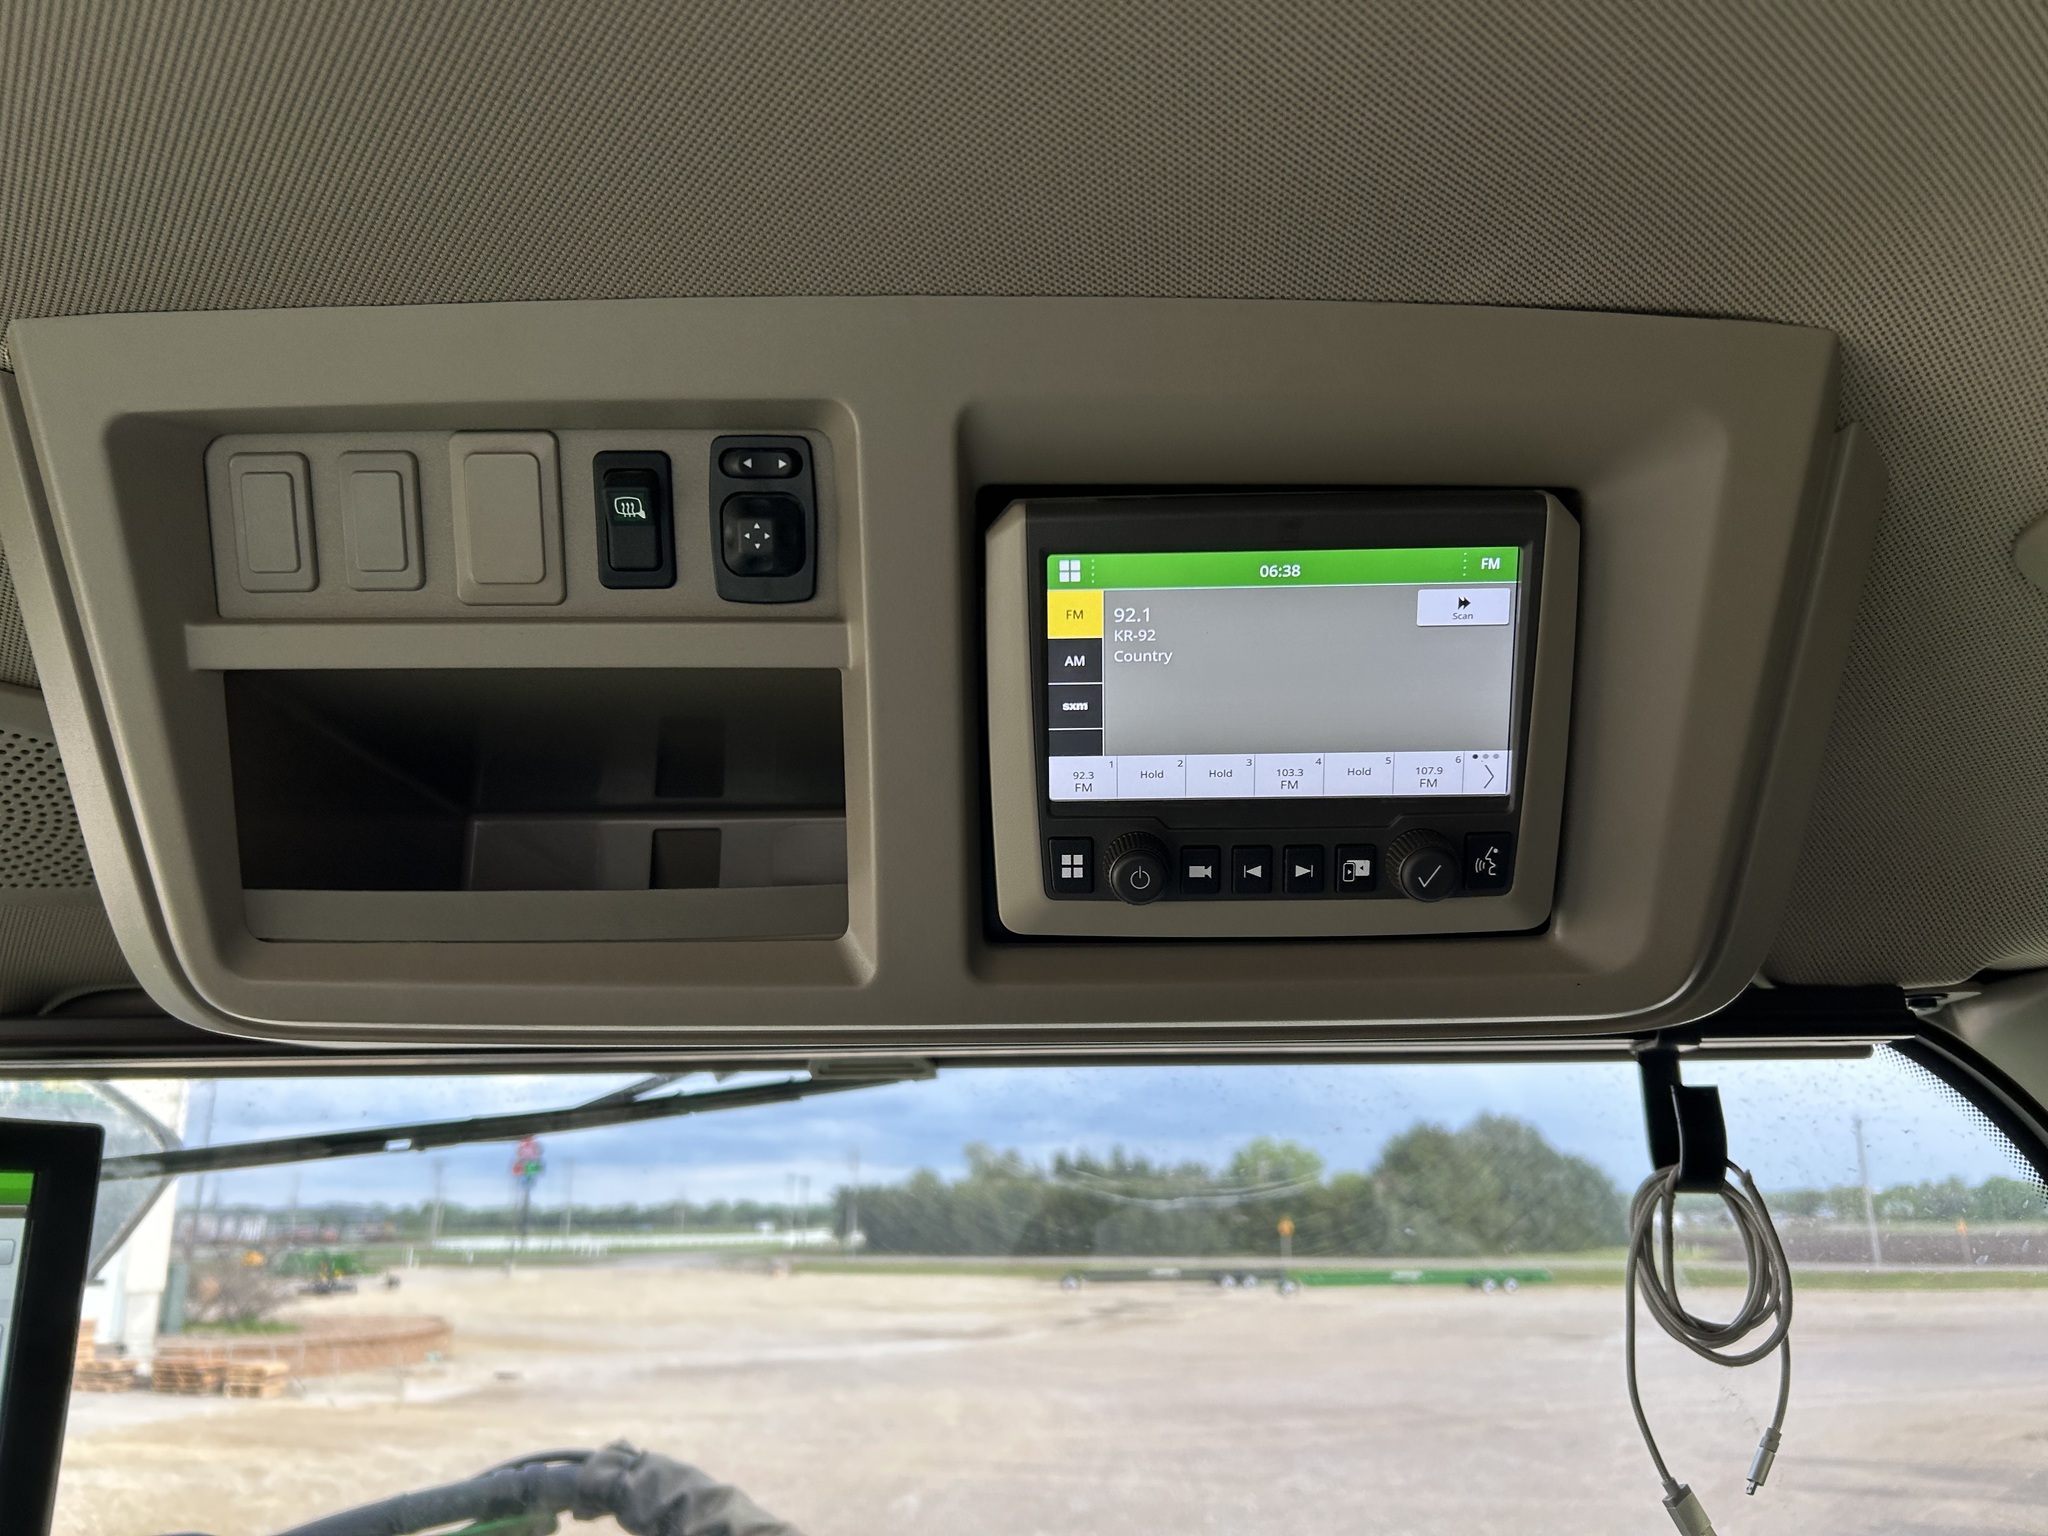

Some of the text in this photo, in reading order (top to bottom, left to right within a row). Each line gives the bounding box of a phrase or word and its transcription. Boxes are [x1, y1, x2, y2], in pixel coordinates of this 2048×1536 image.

[1481, 557, 1501, 570] FM
[1259, 564, 1301, 578] 06:38
[1065, 609, 1084, 620] FM
[1113, 607, 1151, 623] 92.1
[1452, 611, 1473, 620] Scan
[1114, 629, 1156, 641] KR-92
[1064, 655, 1085, 667] AM
[1113, 649, 1173, 664] Country
[1177, 760, 1183, 768] 2
[1455, 756, 1461, 764] 6
[1072, 771, 1095, 780] 92.3
[1140, 769, 1164, 780] Hold
[1208, 768, 1233, 779] Hold
[1276, 769, 1304, 778] 103.3
[1347, 767, 1372, 777] Hold
[1415, 767, 1443, 776] 107.9
[1075, 783, 1093, 793] FM
[1280, 781, 1299, 790] FM
[1419, 778, 1438, 788] FM
